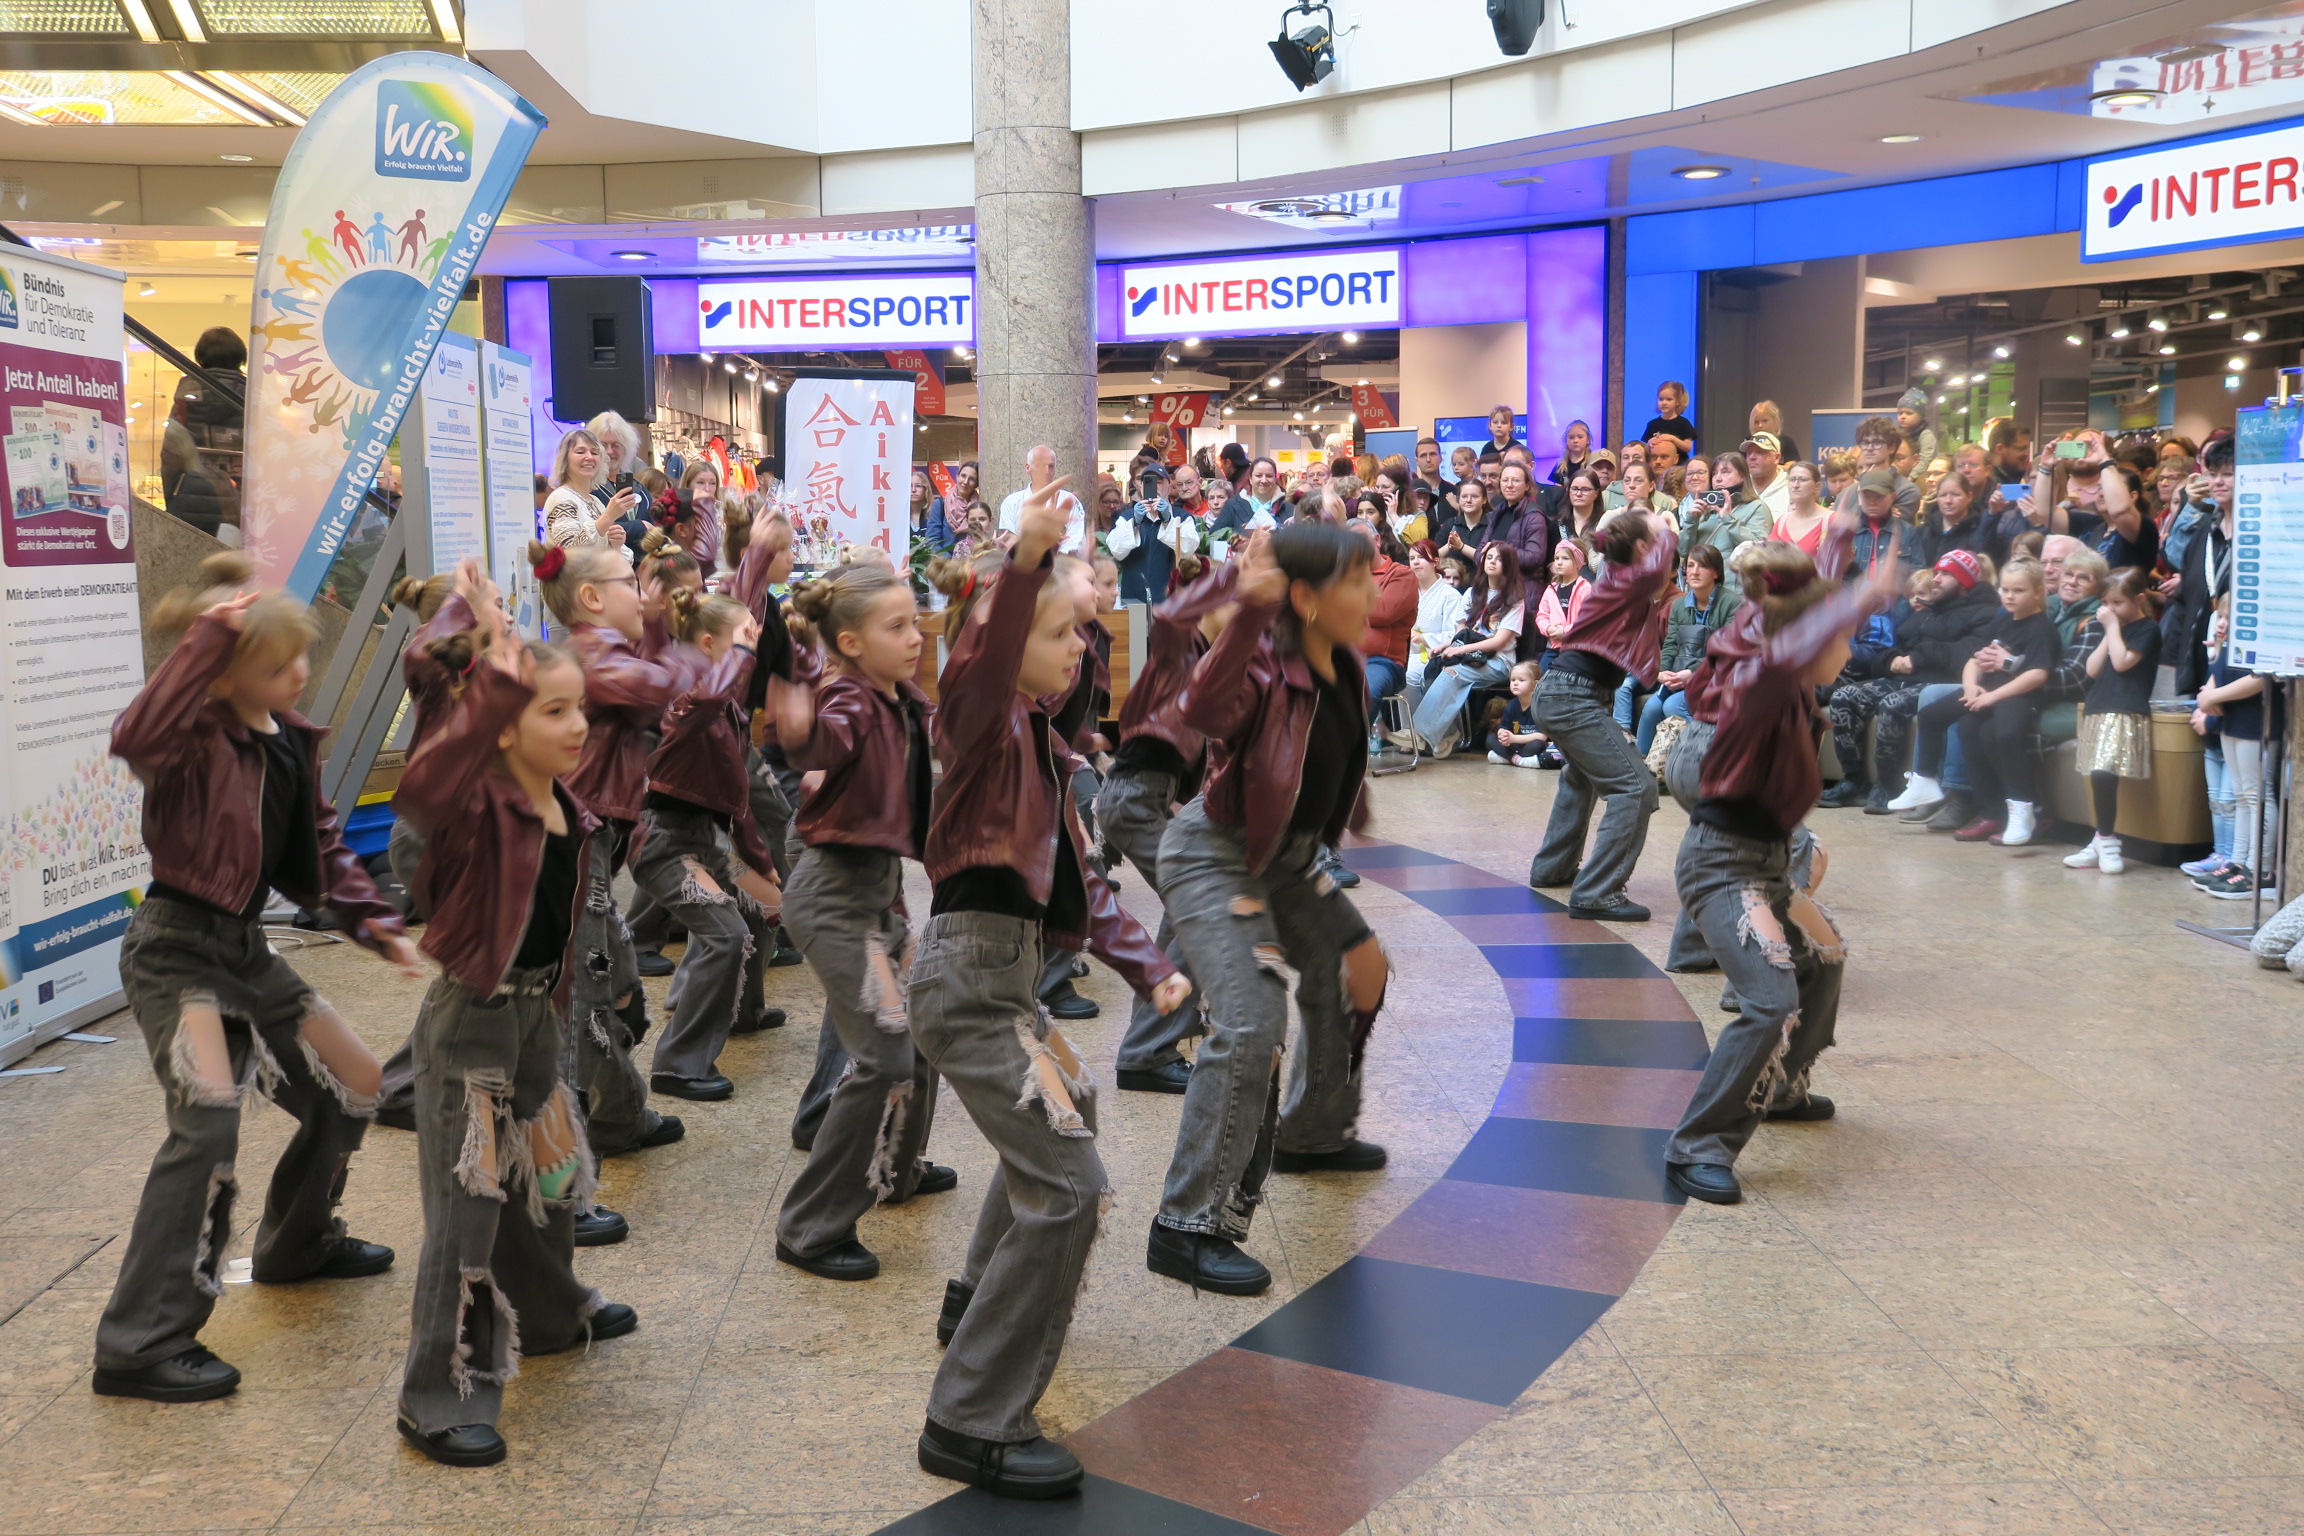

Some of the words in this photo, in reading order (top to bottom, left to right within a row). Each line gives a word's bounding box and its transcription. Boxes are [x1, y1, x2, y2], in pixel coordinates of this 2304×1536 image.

[384, 104, 466, 161] WIR.
[384, 160, 407, 169] Erfolg
[408, 161, 436, 171] braucht
[437, 164, 464, 173] Vielfalt
[2151, 156, 2304, 222] INTER
[23, 272, 65, 297] Bündnis
[1163, 270, 1396, 316] INTERSPORT
[0, 289, 17, 316] IR.
[25, 293, 38, 312] für
[41, 297, 94, 323] Demokratie
[738, 295, 970, 329] INTERSPORT
[27, 318, 47, 335] und
[48, 319, 86, 342] Toleranz
[898, 356, 923, 369] FÜR
[5, 366, 34, 393] Jetzt
[37, 370, 73, 396] Anteil
[76, 375, 119, 401] haben!
[316, 210, 492, 556] wir-erfolg-braucht-vielfalt.de
[916, 372, 929, 391] 2
[1161, 396, 1194, 426] %
[1358, 390, 1369, 406] 3
[1363, 407, 1384, 418] FÜR
[1513, 425, 1527, 434] FN
[802, 393, 862, 545] 合氣
[932, 464, 940, 474] 3
[869, 400, 896, 576] Aikid
[944, 482, 952, 493] 2
[16, 526, 35, 536] Dieses
[35, 527, 60, 536] exklusive
[17, 540, 35, 550] stärkt
[44, 539, 75, 550] Demokratie
[75, 541, 84, 549] vor
[85, 539, 97, 549] Ort.
[6, 589, 23, 601] Mit
[25, 587, 39, 600] dem
[41, 586, 62, 599] Erwerb
[64, 586, 80, 598] einer
[43, 868, 58, 885] DU
[60, 862, 78, 879] bist,
[80, 857, 97, 872] was
[98, 843, 117, 865] WIR.
[44, 886, 68, 907] Bring
[70, 879, 92, 897] dich
[93, 872, 109, 890] ein,
[111, 863, 138, 883] mach
[0, 909, 12, 928] it!
[33, 905, 134, 952] wir-erfolg-braucht-vielfalt.de
